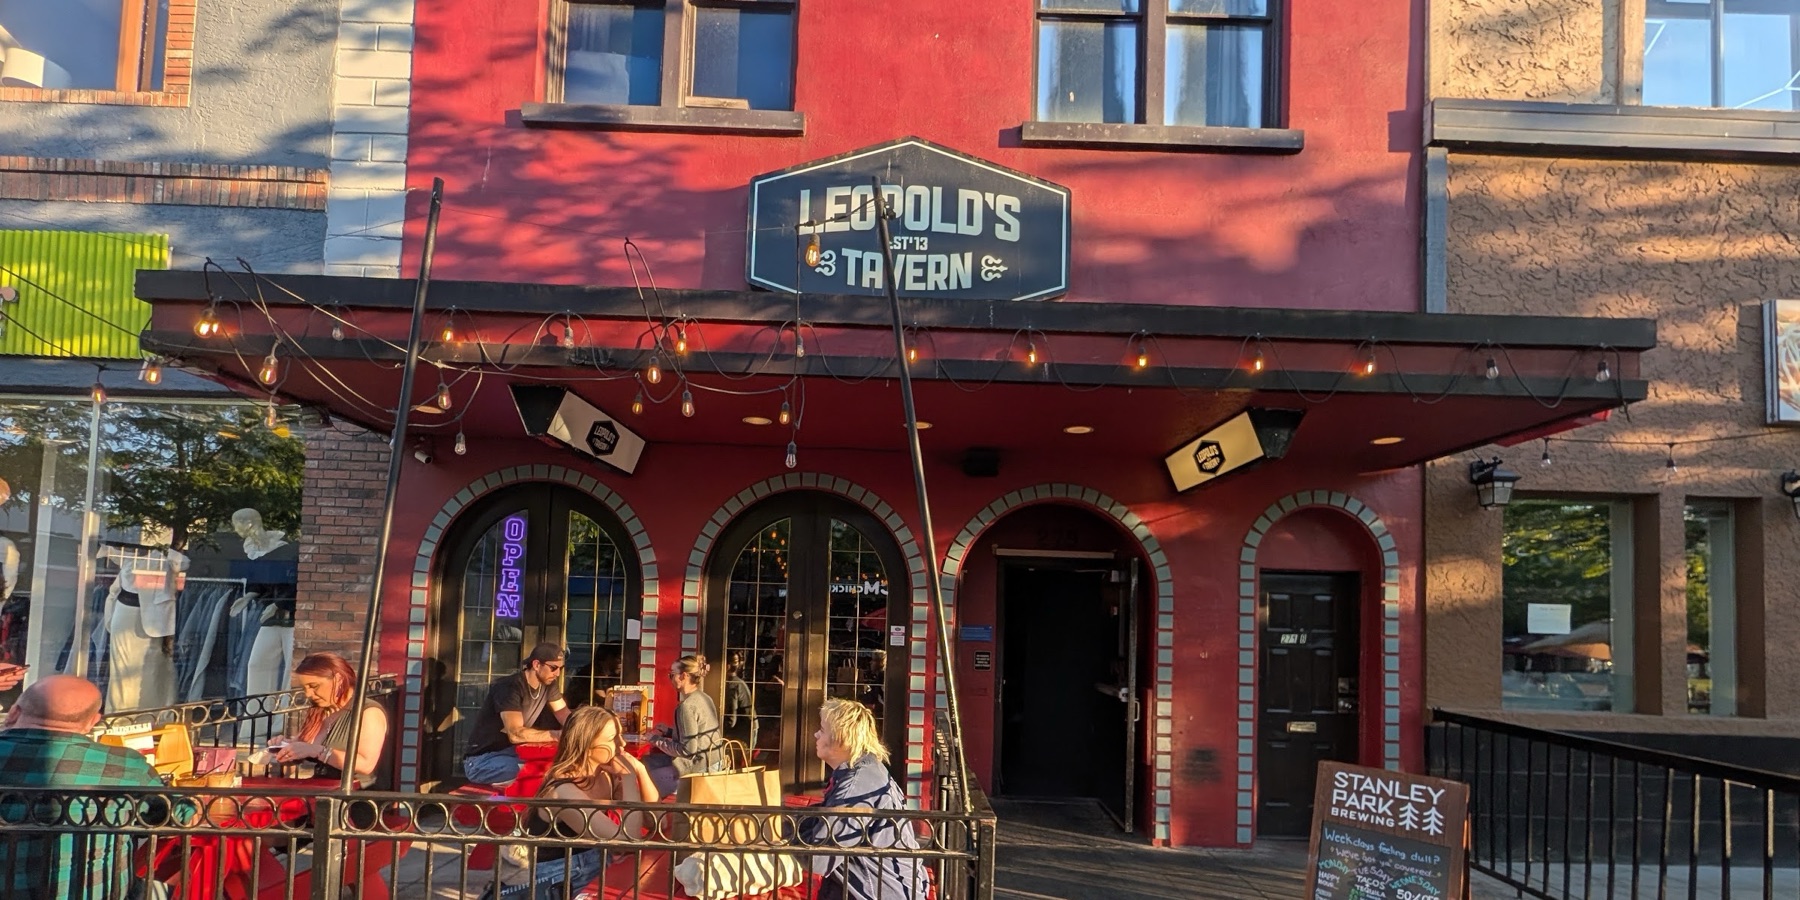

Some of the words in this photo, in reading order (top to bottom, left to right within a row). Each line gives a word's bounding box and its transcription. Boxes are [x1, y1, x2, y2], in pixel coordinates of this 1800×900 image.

[798, 185, 1021, 242] LEOPOLD'S
[496, 518, 525, 617] OPEN
[1334, 771, 1446, 805] STANLEY
[1332, 789, 1395, 816] PARK
[1331, 807, 1395, 828] BREWING
[1324, 827, 1375, 851] Weekdays
[1378, 842, 1406, 860] feeling
[1318, 859, 1351, 875] MONDAY
[1352, 866, 1394, 884] TUESDAY
[1318, 871, 1340, 884] HAPPY
[1356, 874, 1386, 890] TACOS
[1389, 875, 1441, 895] WEDNESDAY
[1354, 884, 1387, 898] TEQUILA
